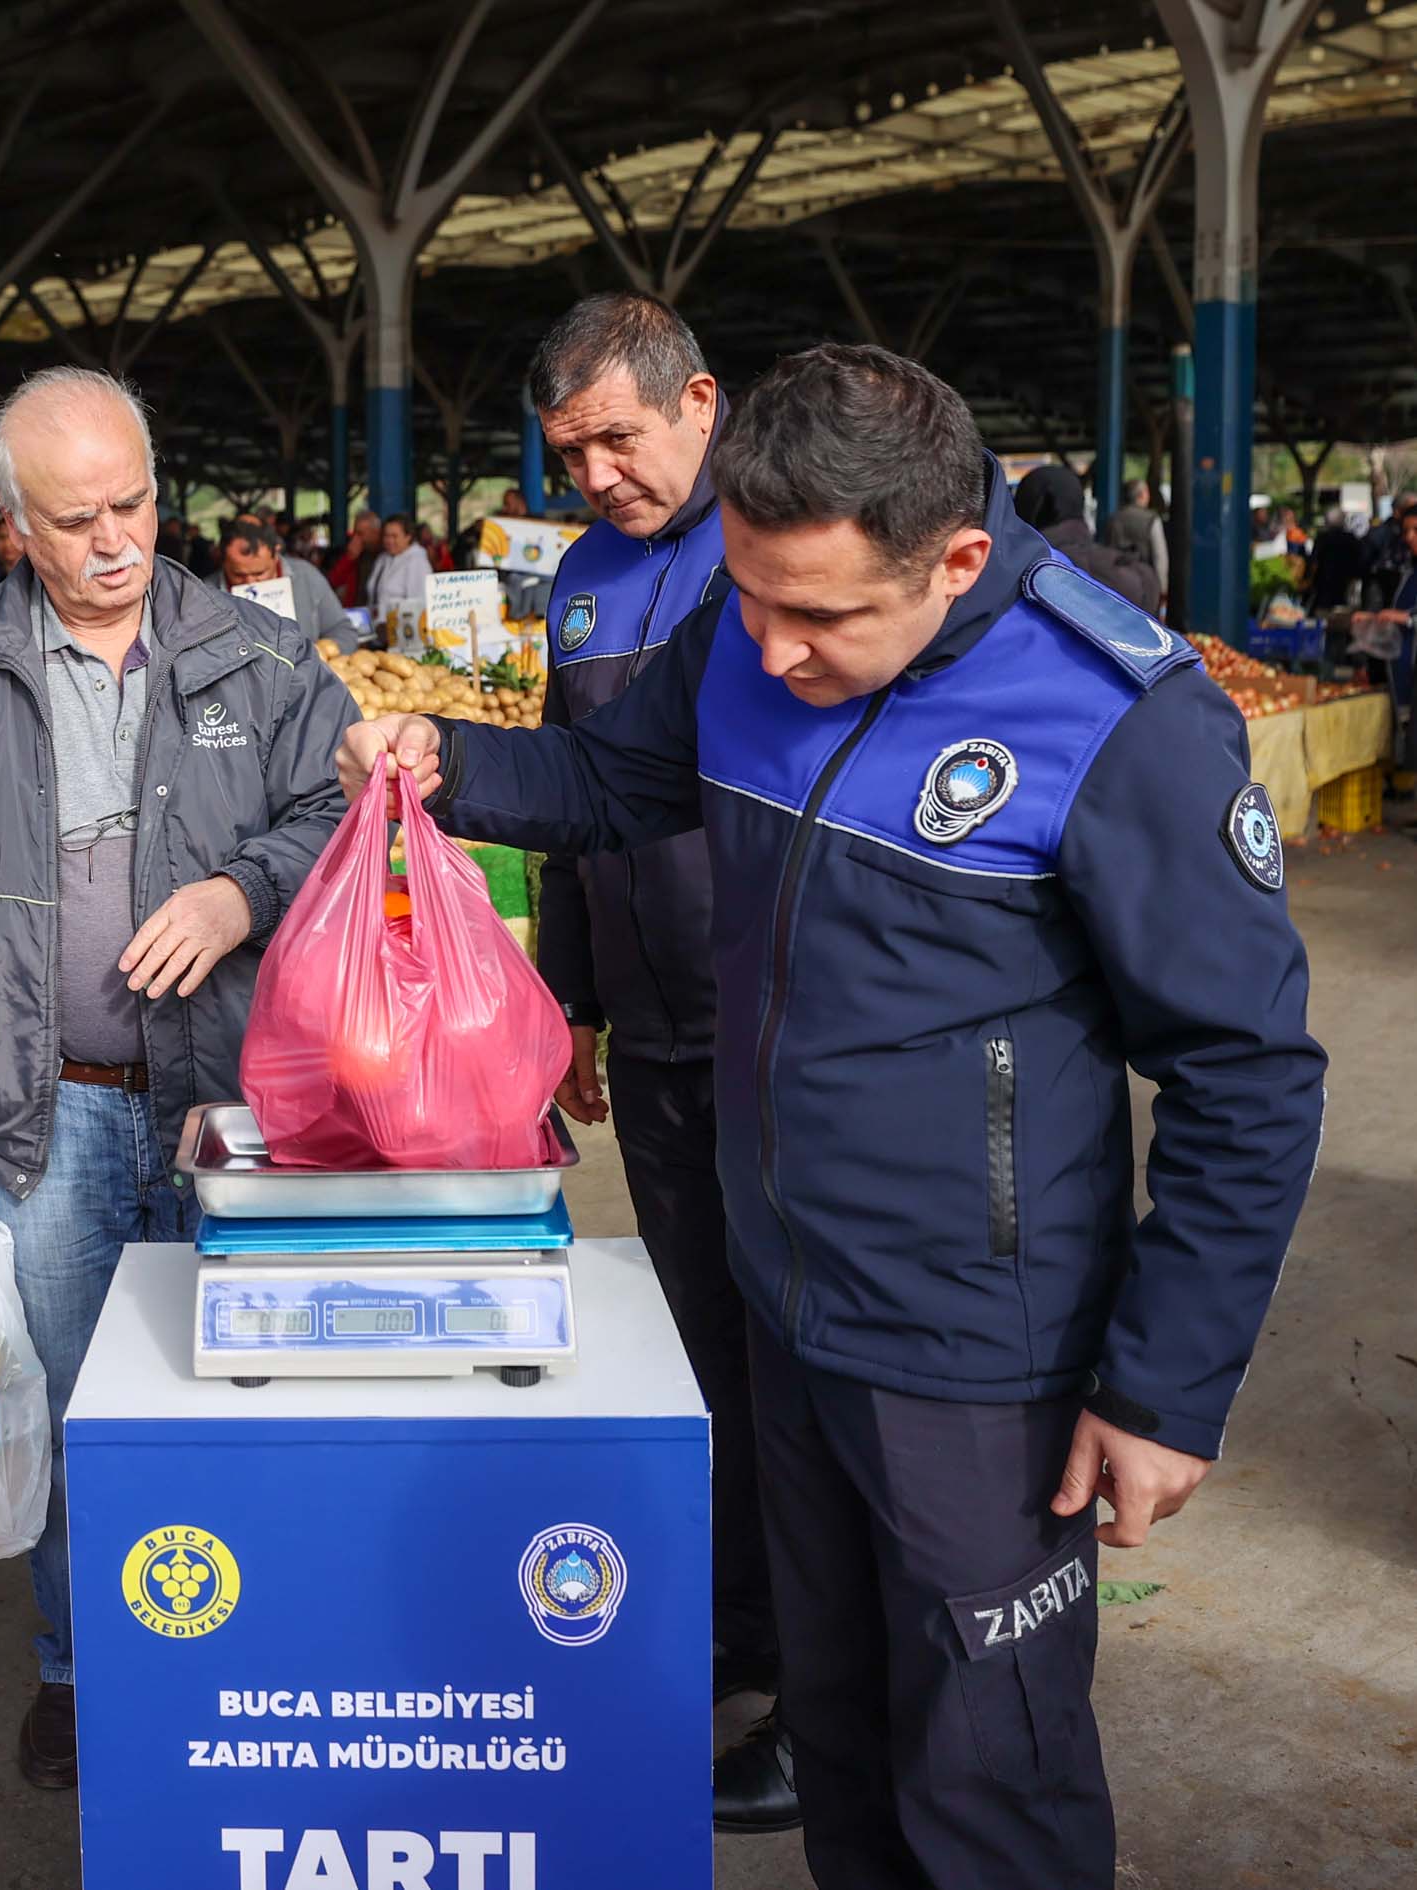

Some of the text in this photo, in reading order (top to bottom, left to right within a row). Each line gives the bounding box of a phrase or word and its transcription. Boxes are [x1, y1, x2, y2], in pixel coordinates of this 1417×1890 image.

[192, 733, 248, 749] Services
[197, 721, 240, 737] Eurest
[968, 743, 1010, 768] ZABITA
[145, 1530, 214, 1551] BUCA
[545, 1532, 600, 1552] ZABITA
[131, 1598, 234, 1636] BELEDİYESİ
[974, 1557, 1091, 1647] ZABITA
[219, 1684, 535, 1720] BUCA BELEDİYESİ
[188, 1735, 566, 1771] ZABITA MÜDÜRLÜĞÜ
[221, 1828, 536, 1890] TARTI
